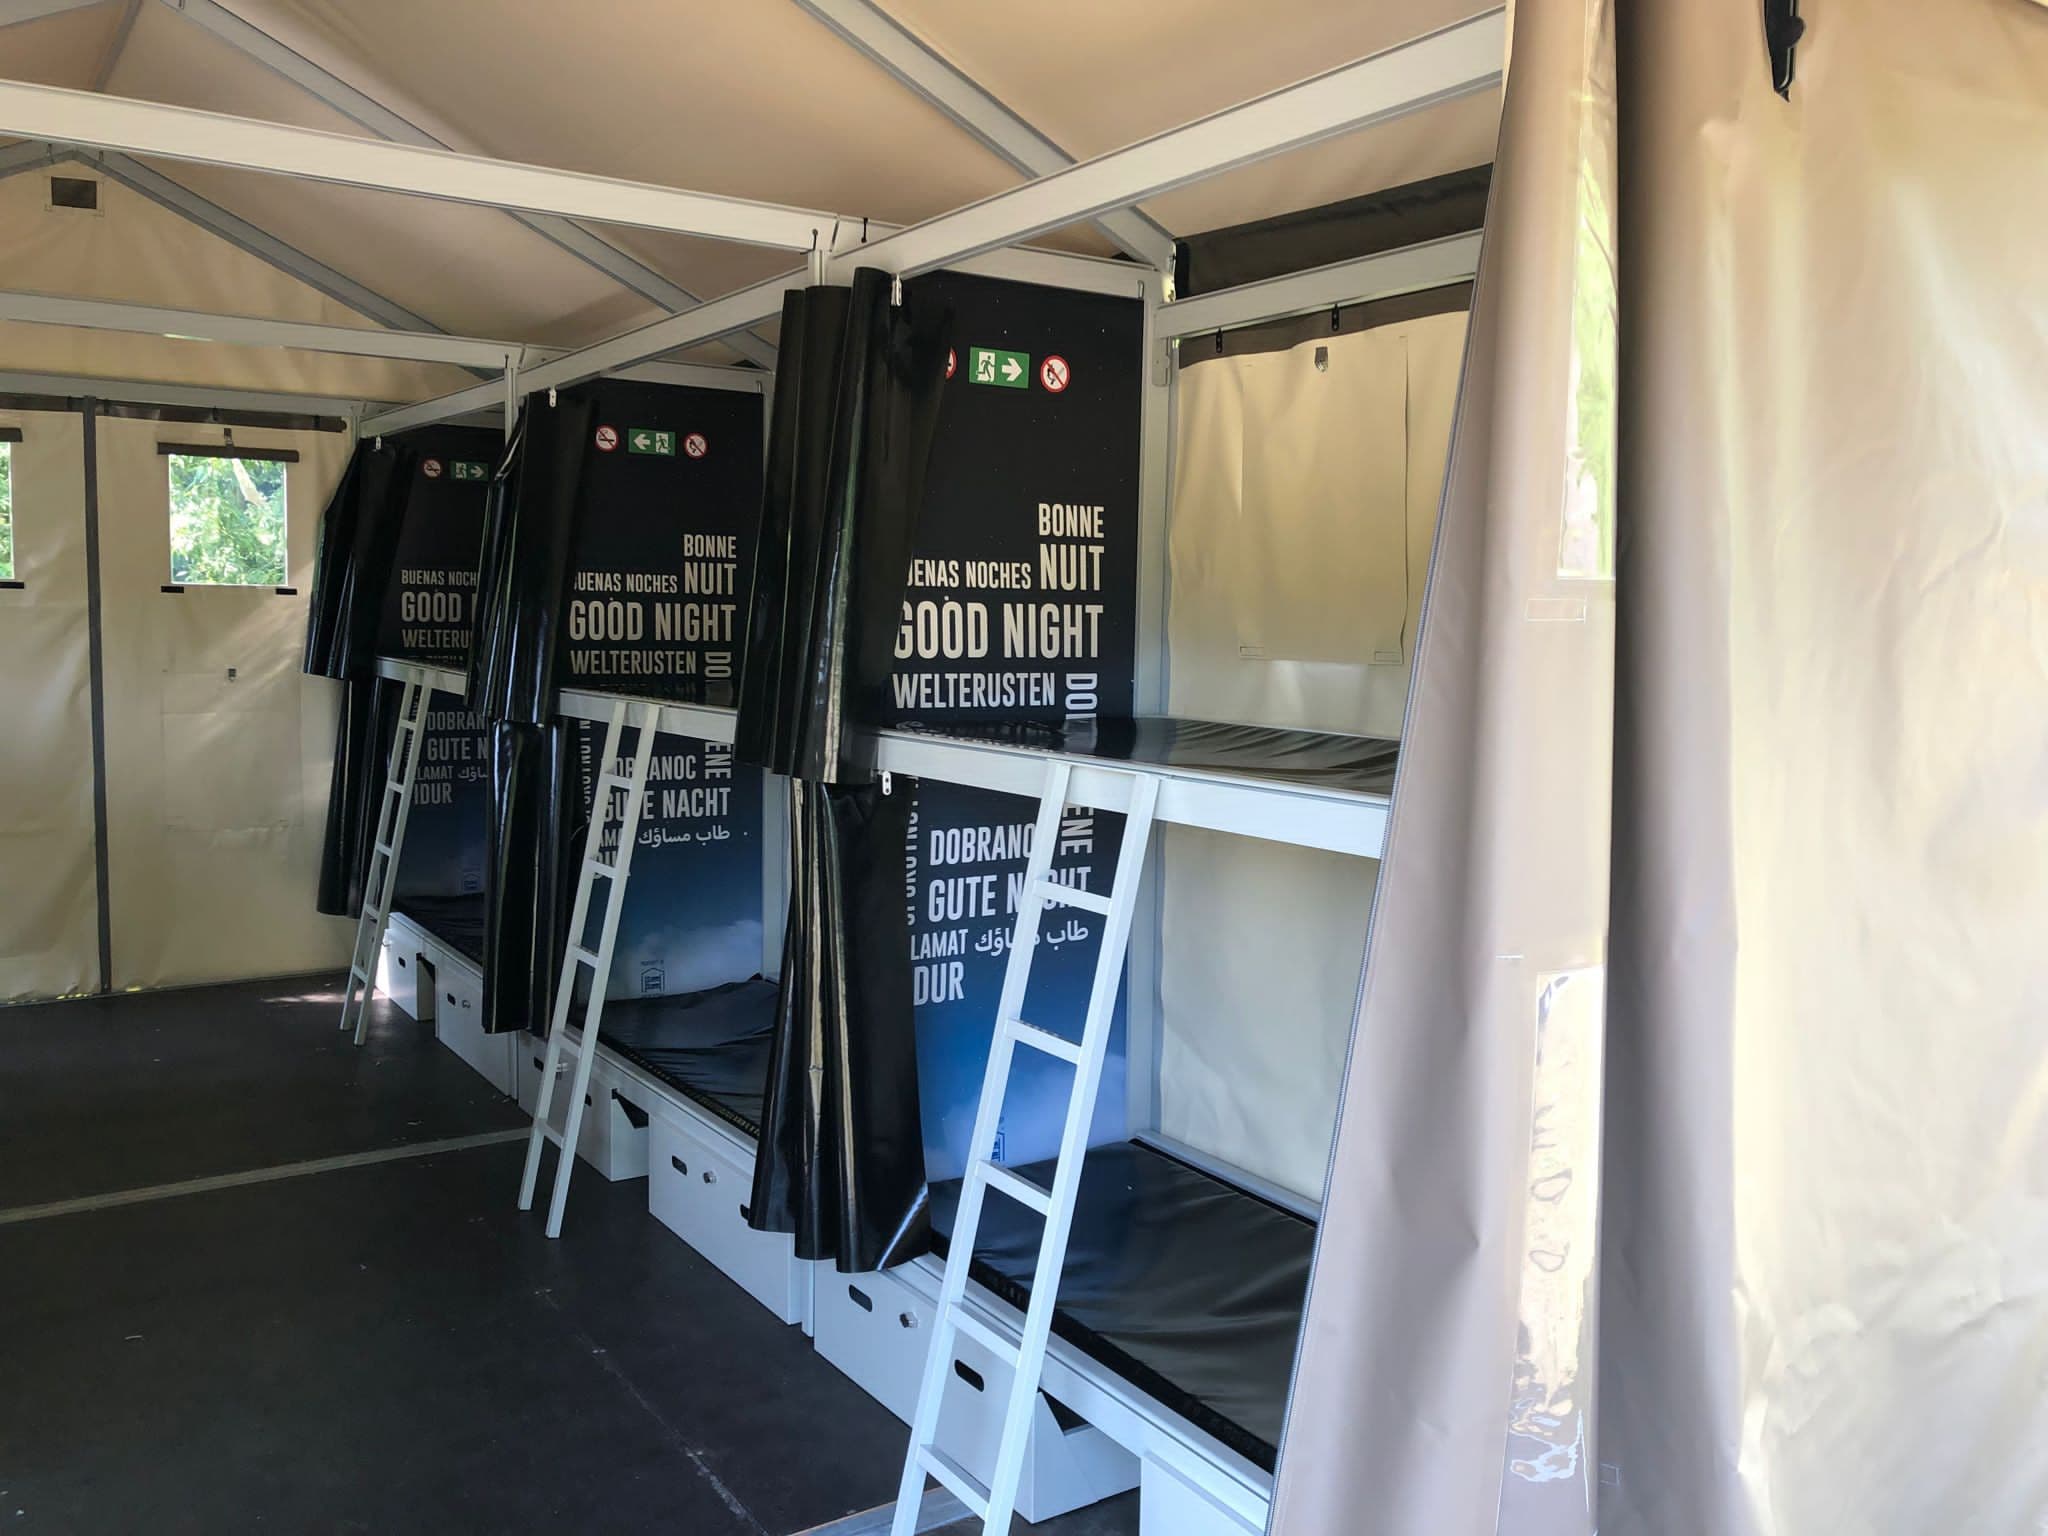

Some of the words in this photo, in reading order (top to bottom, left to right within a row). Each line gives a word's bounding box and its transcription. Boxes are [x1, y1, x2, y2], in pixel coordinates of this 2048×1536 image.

[1038, 503, 1105, 538] BONNE
[684, 534, 737, 558] BONNE
[401, 569, 446, 585] BUENAS
[574, 571, 621, 592] UENAS
[626, 573, 678, 593] NOCHES
[684, 562, 737, 595] NUIT
[965, 561, 1032, 589] NOCHES
[1040, 543, 1105, 591] NUIT
[401, 591, 462, 622] GOOD
[570, 599, 644, 641] GOOD
[655, 603, 737, 642] NIGHT
[402, 629, 473, 649] WELTERU
[894, 600, 989, 659] GOOD
[1003, 603, 1104, 659] NIGHT
[570, 650, 697, 675] WELTERUSTEN
[892, 672, 1056, 709] WELTERUSTEN
[1065, 673, 1098, 720] DO
[427, 737, 472, 761] GUTE
[663, 786, 731, 819] NACHT
[695, 825, 730, 846] طاب
[928, 875, 998, 922] GUTE
[911, 929, 968, 960] LAMAT
[1047, 920, 1089, 948] طاب
[913, 961, 964, 1006] DUR
